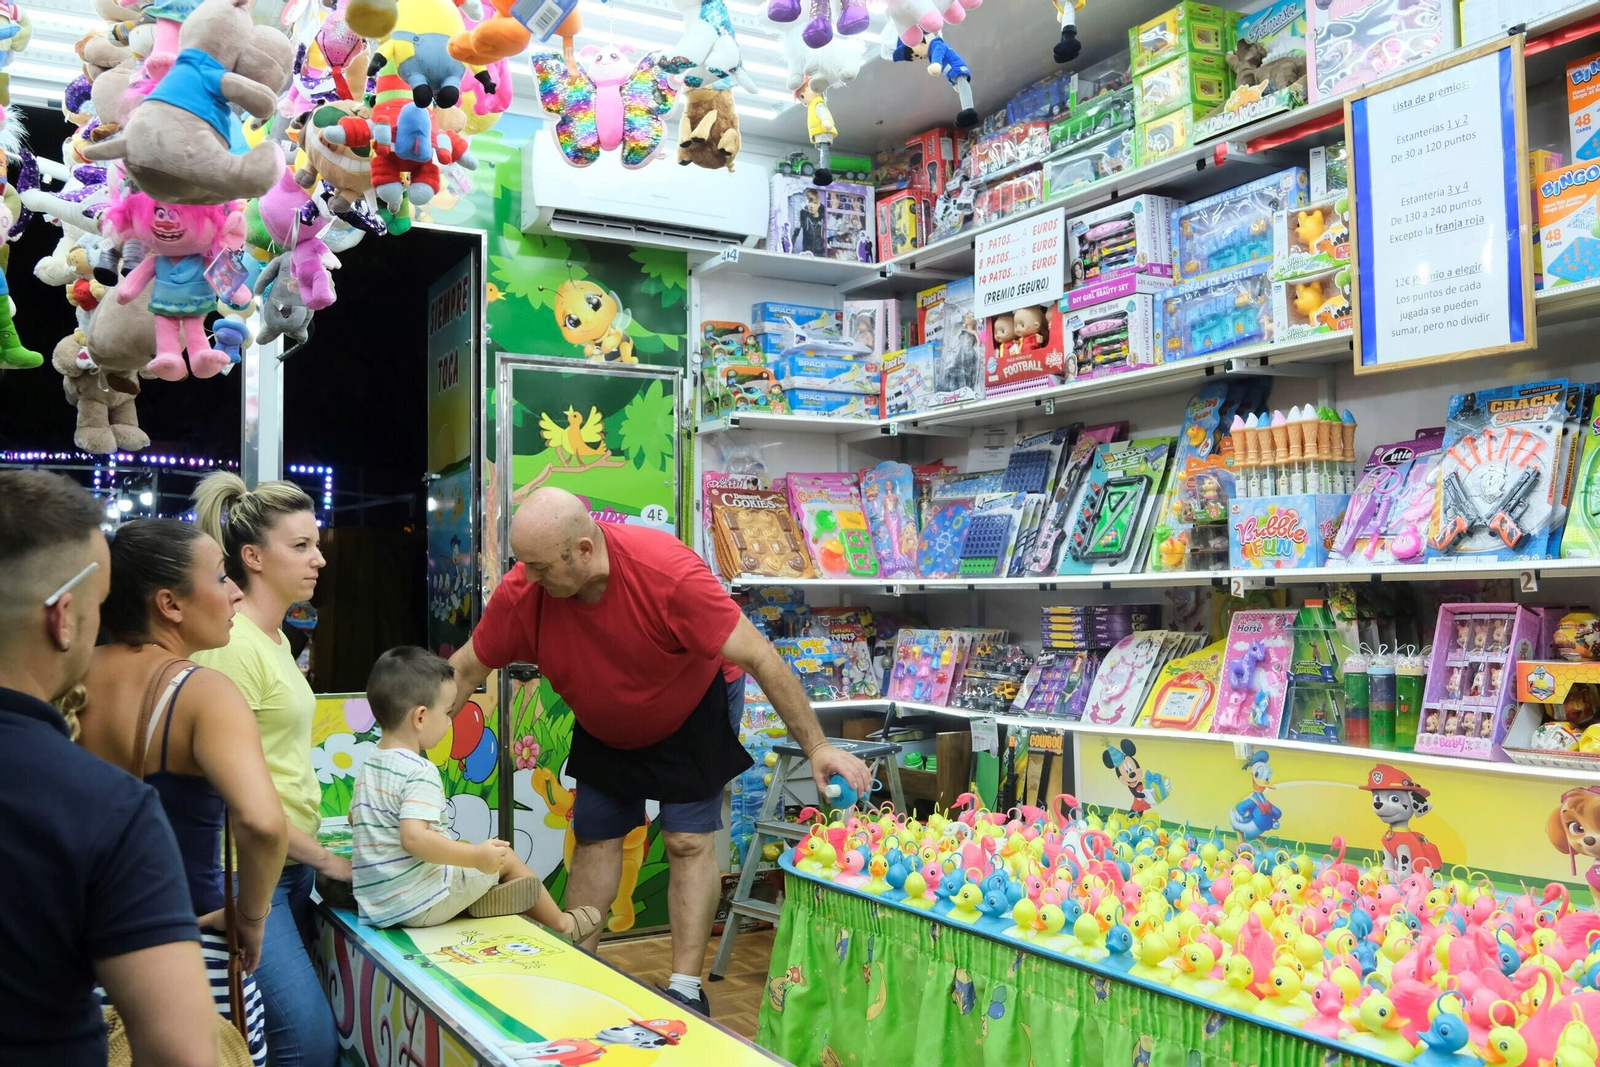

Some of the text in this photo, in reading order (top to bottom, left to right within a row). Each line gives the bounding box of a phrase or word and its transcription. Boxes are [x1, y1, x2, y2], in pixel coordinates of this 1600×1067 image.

[1248, 3, 1303, 42] Famosa
[1393, 80, 1470, 112] Lista de premios:
[1209, 97, 1277, 131] DINO WORLD
[1574, 113, 1591, 127] 48
[1396, 114, 1469, 145] Estanterías 1 y 2
[1576, 126, 1592, 134] CARDS
[1391, 153, 1402, 164] De
[1404, 149, 1417, 161] 30
[1426, 142, 1442, 155] 120
[1444, 131, 1477, 149] puntos
[1540, 164, 1600, 198] BINGO
[1220, 191, 1235, 203] ICE
[1401, 181, 1469, 207] Estantería 3 y 4
[1391, 216, 1402, 227] De
[1404, 211, 1421, 224] 130
[1430, 204, 1447, 218] 240
[1449, 197, 1482, 217] puntos
[1542, 201, 1557, 209] Have
[1556, 199, 1566, 207] fun
[979, 242, 984, 253] 3
[1022, 228, 1027, 237] 4
[1032, 218, 1058, 236] EUROS
[1390, 213, 1485, 246] Excepto la franja roja
[1544, 228, 1561, 242] 48
[979, 259, 983, 270] 8
[1021, 247, 1026, 257] 8
[1032, 236, 1058, 253] EUROS
[1546, 240, 1562, 249] CARDS
[730, 249, 738, 260] 4
[1286, 255, 1304, 266] Dino
[979, 275, 987, 286] 14
[1019, 266, 1028, 276] 12
[1032, 254, 1058, 271] EUROS
[1395, 276, 1410, 288] 12€
[1455, 262, 1482, 281] elegir
[1178, 281, 1206, 295] DREAM
[1206, 276, 1220, 287] ICE
[1222, 267, 1253, 283] CASTLE
[922, 293, 937, 306] Track
[984, 276, 1050, 305] (PREMIO SEGURO)
[1072, 283, 1129, 305] DIY GIRL BEAUTY SET
[1396, 281, 1482, 305] Los puntos de cada
[429, 274, 469, 336] SIEMPRE
[769, 306, 796, 315] SPACE
[1098, 305, 1107, 314] my
[1107, 302, 1119, 311] love
[1399, 298, 1478, 322] jugada se pueden
[1391, 312, 1490, 338] sumar, pero no dividir
[438, 347, 459, 393] TOCA
[798, 360, 826, 369] SPACE
[883, 357, 898, 369] Track
[1003, 360, 1043, 378] FOOTBALL
[798, 393, 826, 402] SPACE
[1046, 400, 1053, 413] 3
[1490, 391, 1560, 414] CRACK
[722, 418, 729, 430] 3
[1495, 407, 1549, 426] SHOT
[890, 423, 897, 435] 3
[1023, 434, 1054, 449] Connect
[1570, 437, 1578, 463] SUPERIOR
[1101, 445, 1151, 463] SNOOKER
[1380, 448, 1413, 464] Cutie
[721, 493, 777, 509] COOKIES
[734, 493, 761, 501] Dessert
[977, 497, 986, 509] 4
[1235, 514, 1307, 545] Bubble
[1251, 537, 1294, 556] FUN
[1232, 580, 1241, 596] 2
[1520, 571, 1534, 591] 2
[893, 585, 900, 597] 2
[1236, 623, 1262, 633] Horse
[1438, 736, 1466, 751] Baby
